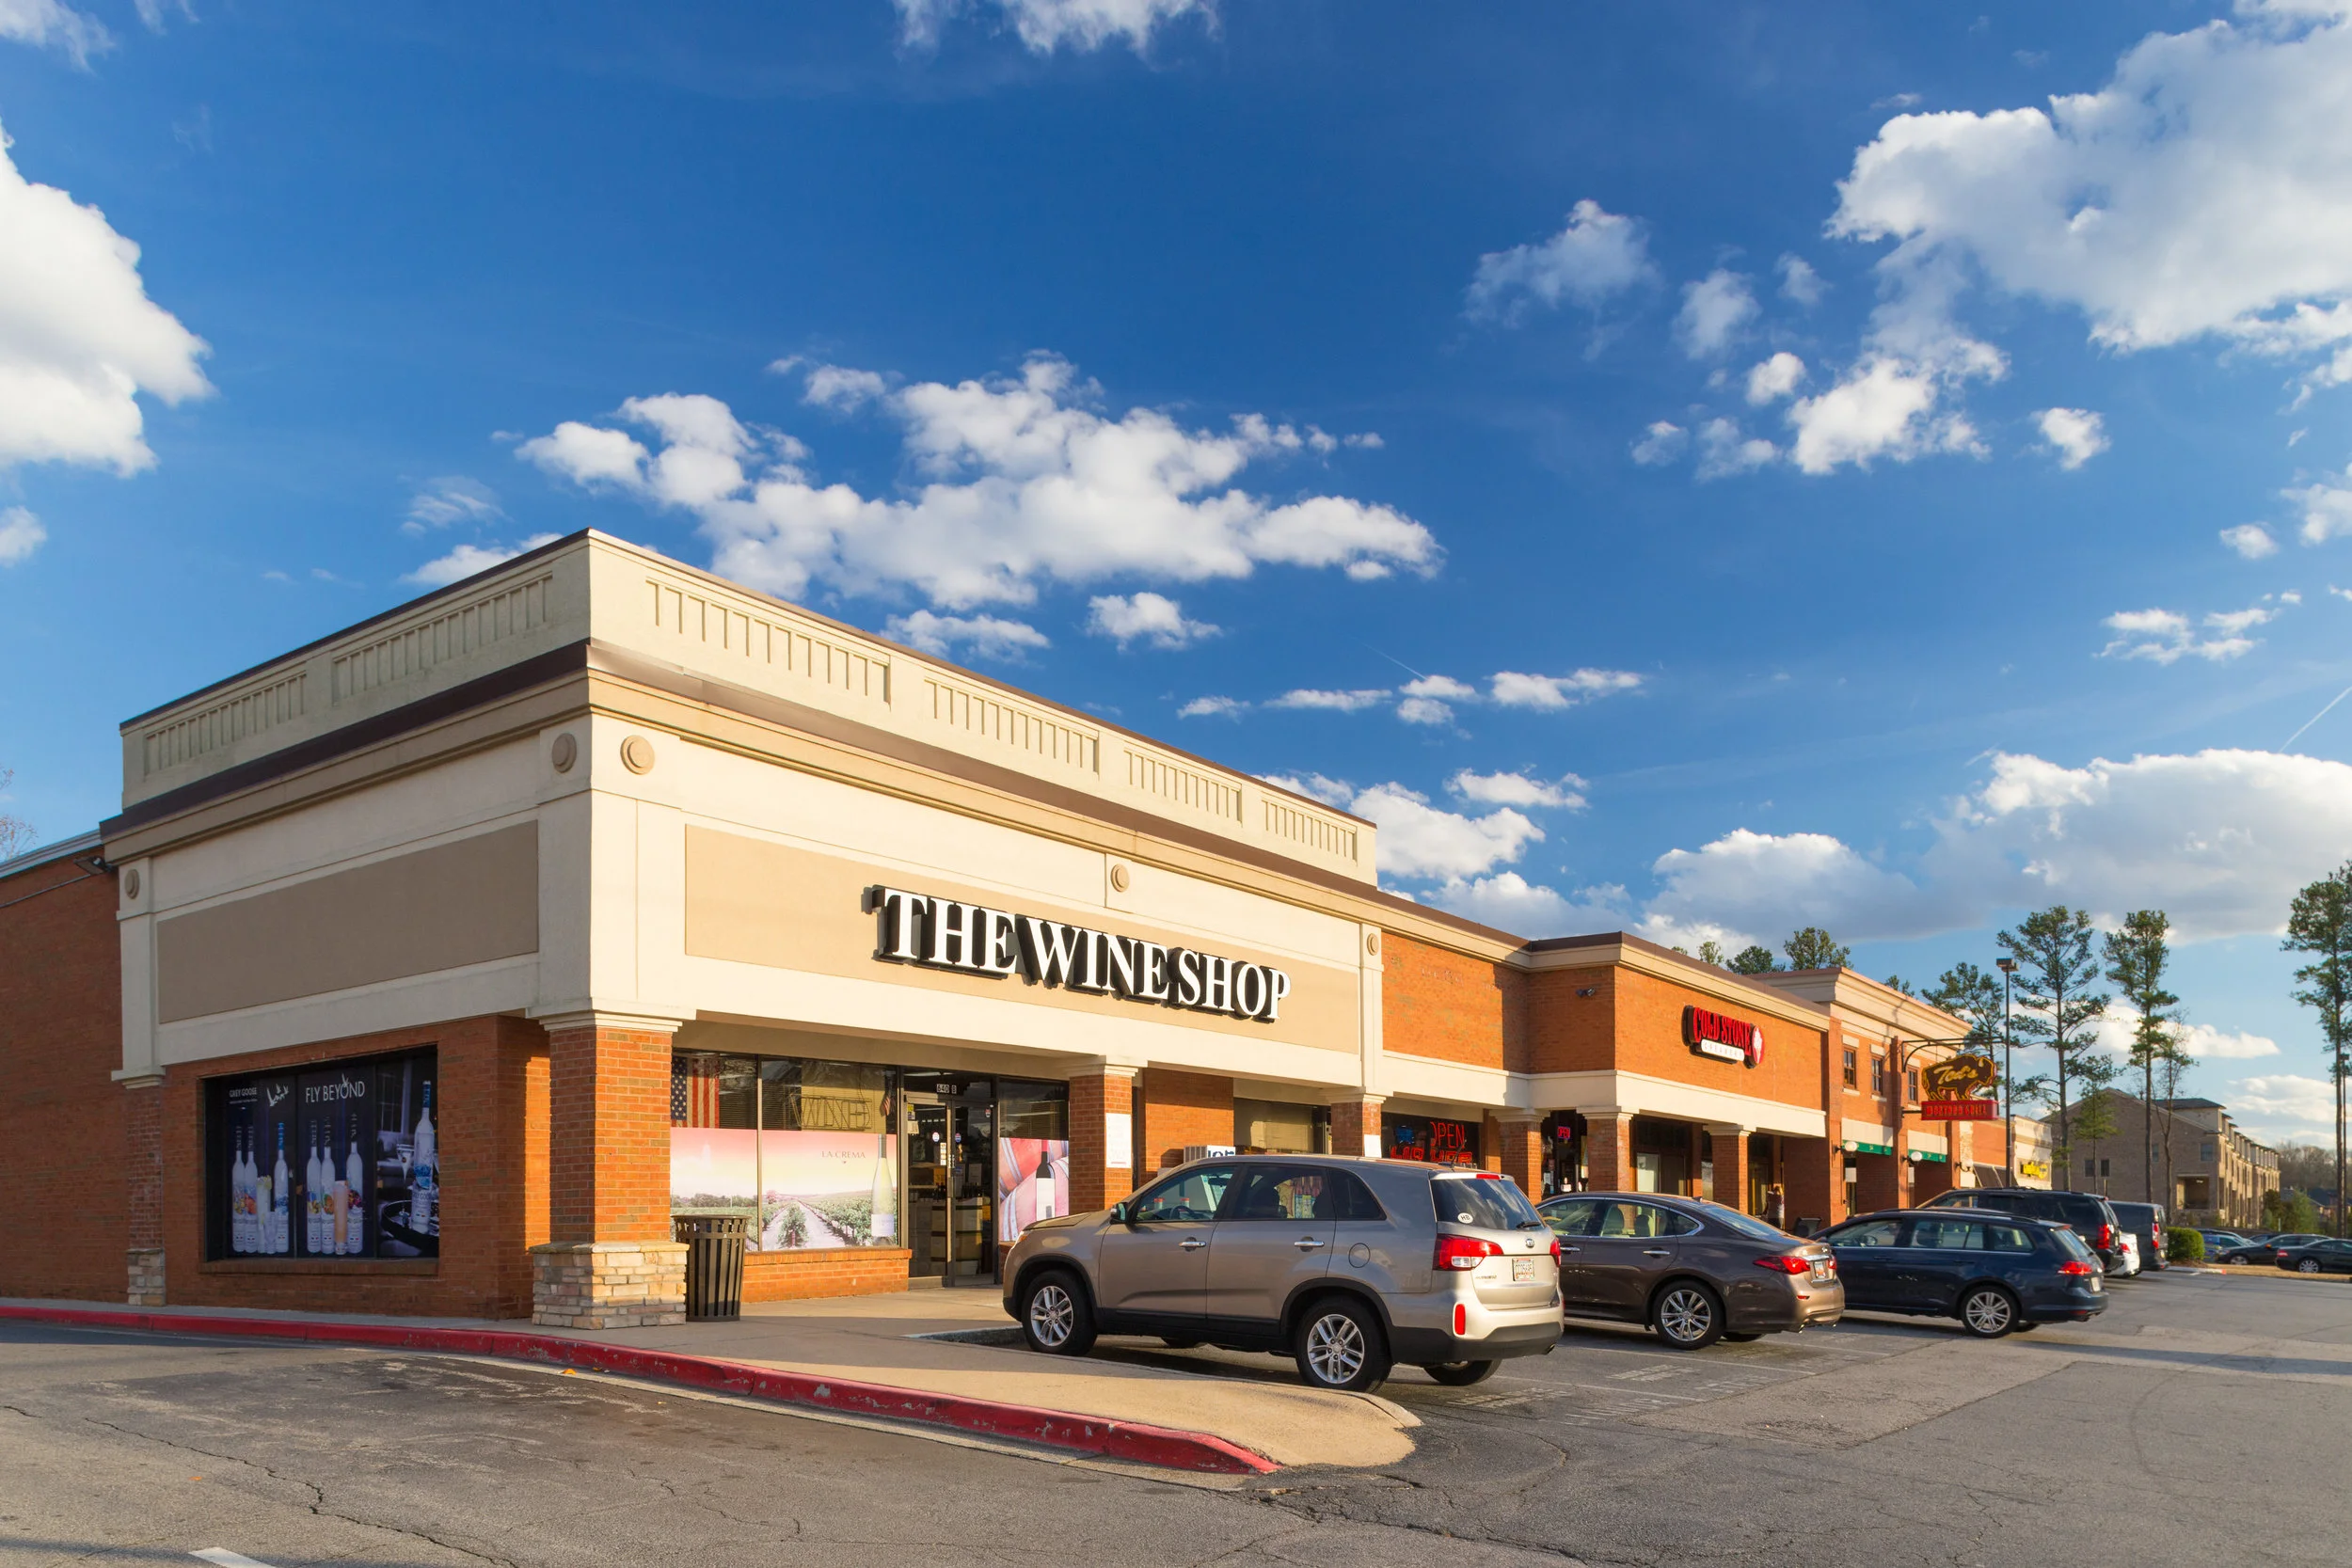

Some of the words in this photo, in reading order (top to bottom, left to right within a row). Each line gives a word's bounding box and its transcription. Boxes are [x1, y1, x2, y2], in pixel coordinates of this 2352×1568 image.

[883, 888, 1017, 974] THE
[1023, 916, 1169, 1001] WINE
[1178, 948, 1291, 1021] SHOP
[1693, 1007, 1720, 1042] COLD
[1721, 1016, 1751, 1055] STONE
[306, 1085, 321, 1103] FLY
[323, 1080, 365, 1101] BEYOND
[1933, 1065, 1979, 1085] Ted's
